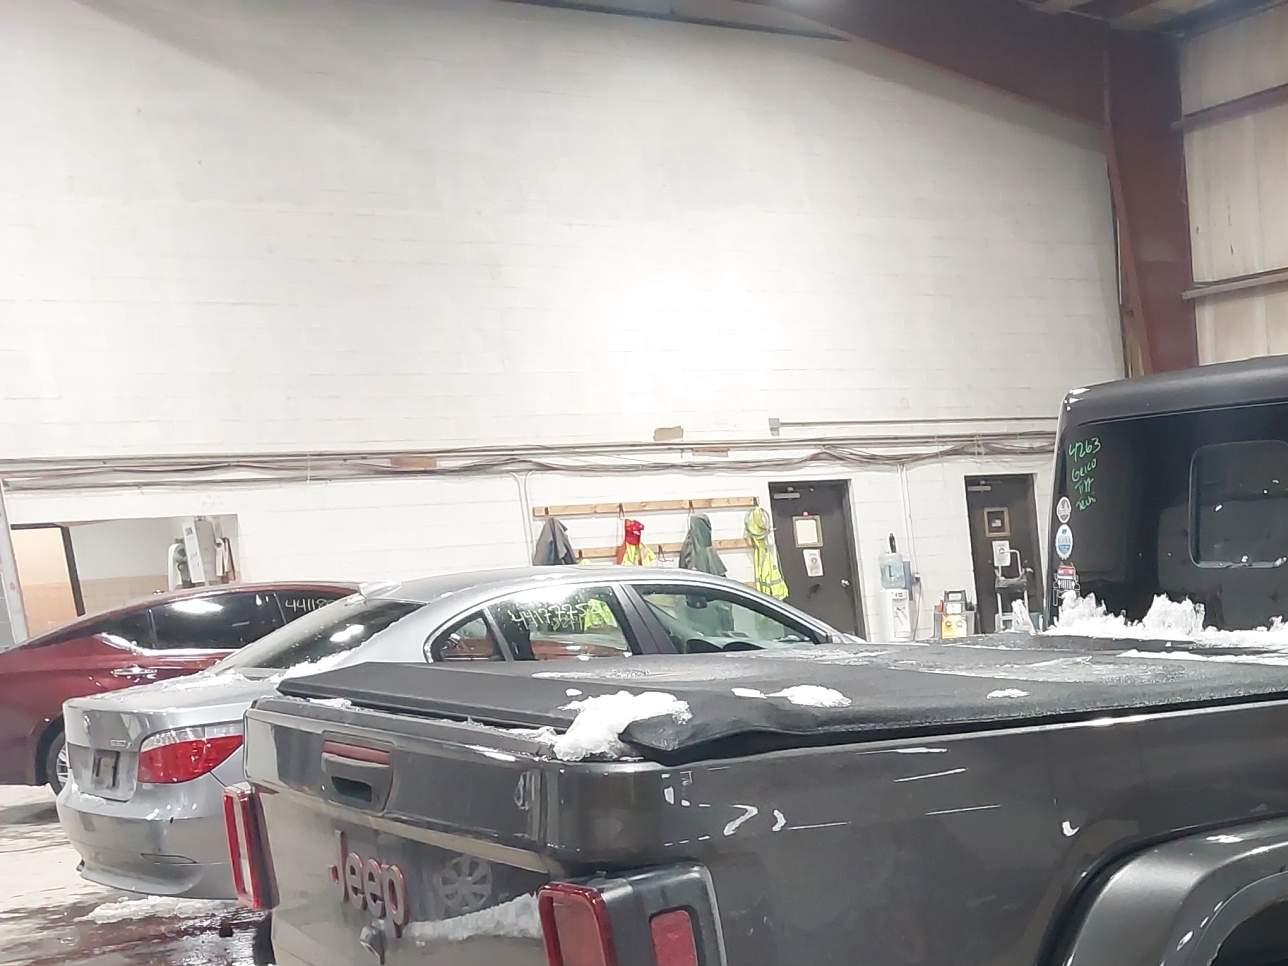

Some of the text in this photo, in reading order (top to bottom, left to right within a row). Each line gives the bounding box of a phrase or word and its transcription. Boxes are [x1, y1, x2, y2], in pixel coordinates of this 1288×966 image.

[1068, 437, 1102, 463] 4263
[285, 598, 336, 612] 44118
[328, 829, 412, 940] Jeep
